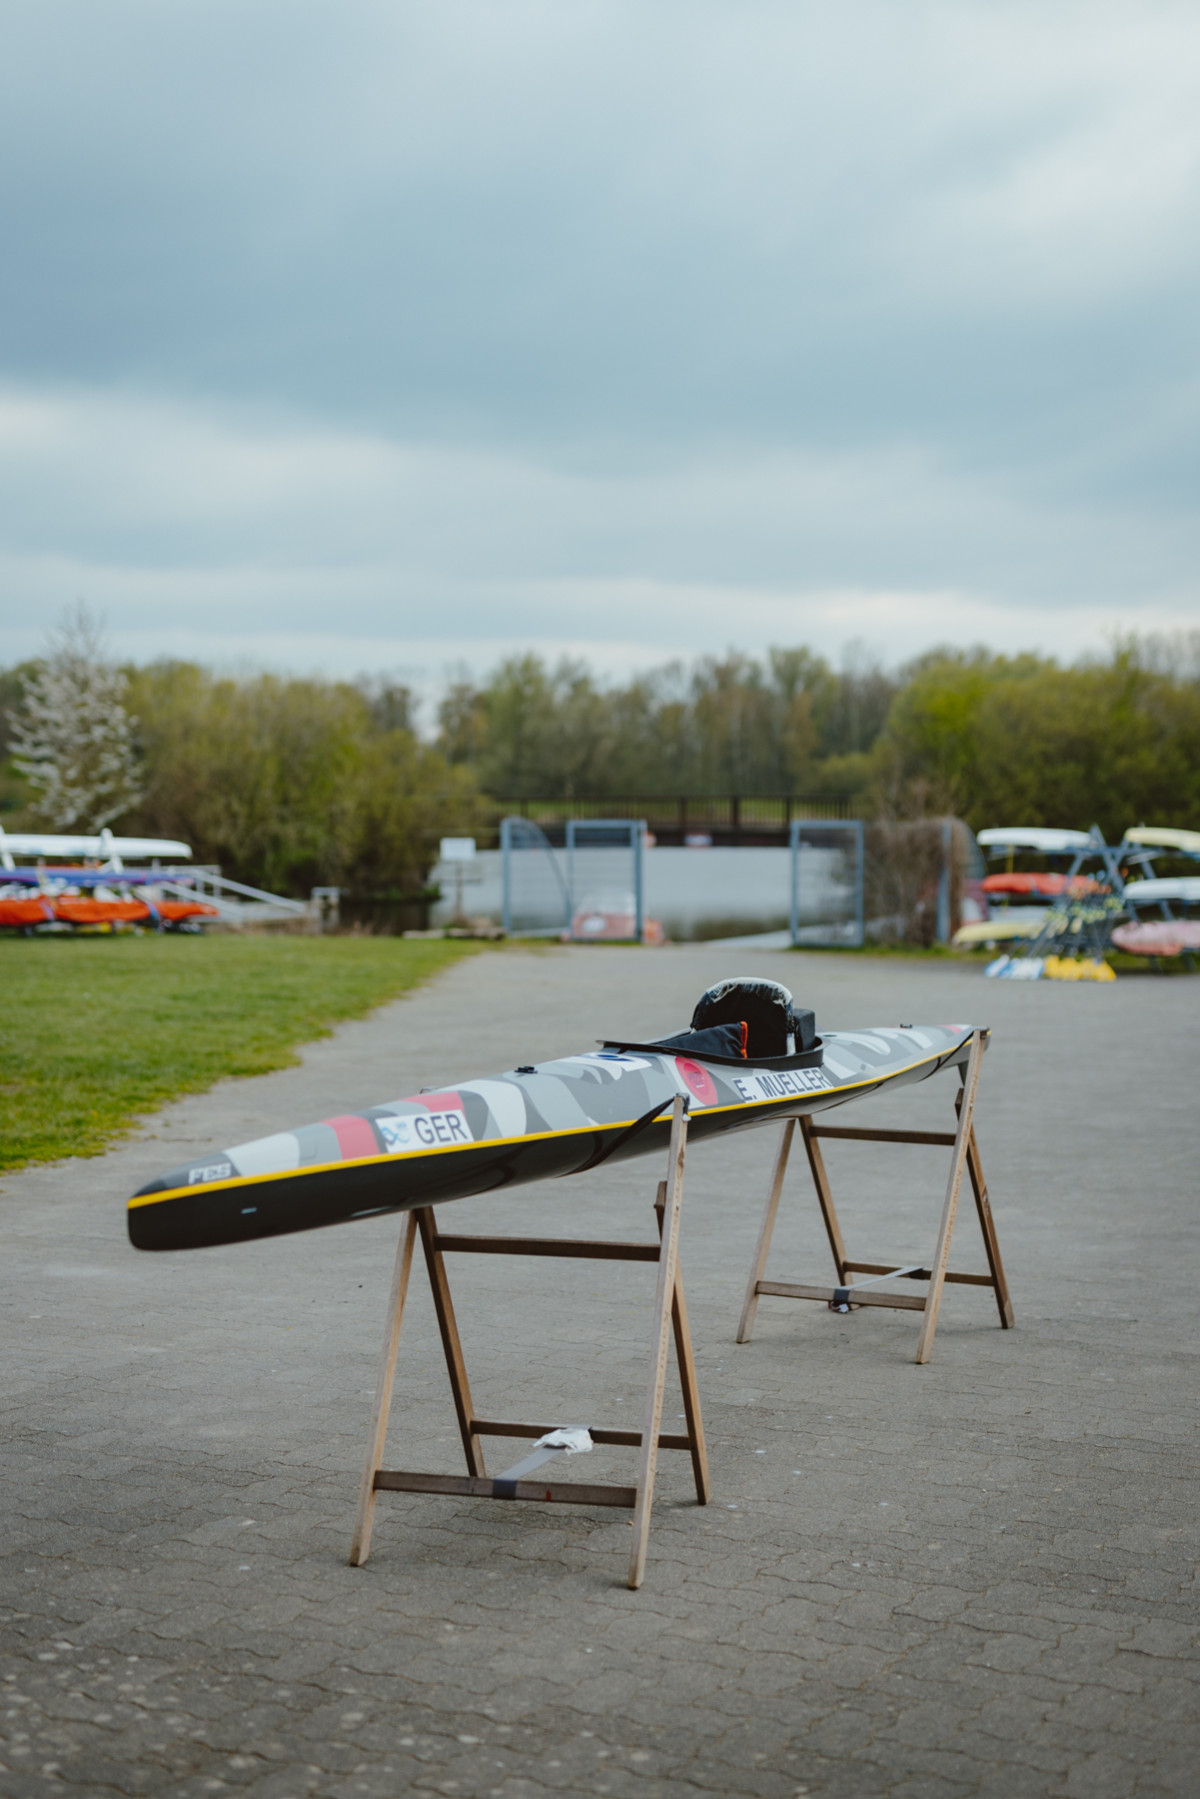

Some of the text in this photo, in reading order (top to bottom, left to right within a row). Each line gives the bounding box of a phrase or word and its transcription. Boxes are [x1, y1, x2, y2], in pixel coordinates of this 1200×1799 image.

[733, 1079, 756, 1101] E.
[755, 1069, 832, 1098] MUELLER
[414, 1113, 468, 1145] GER
